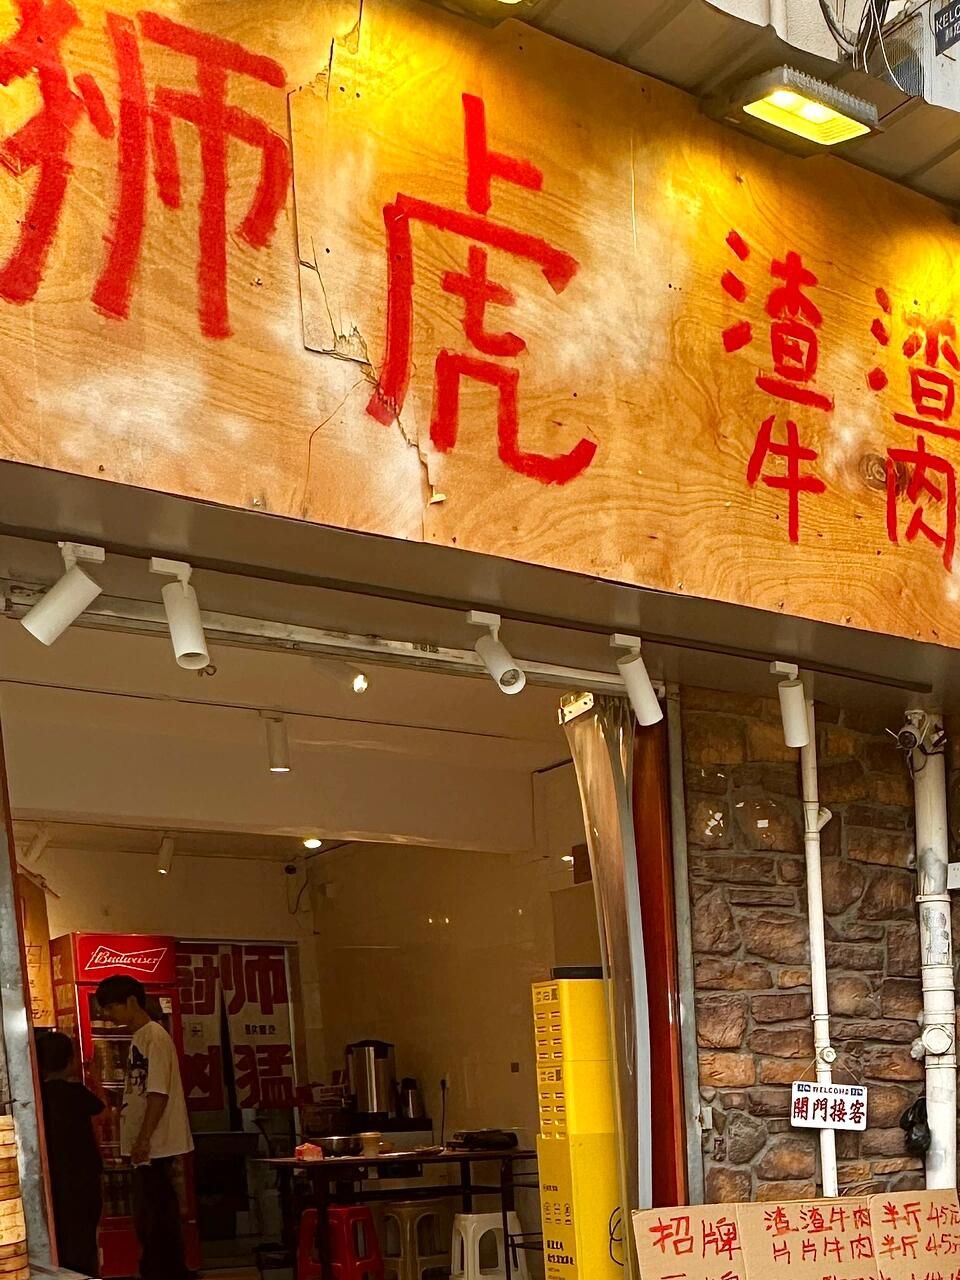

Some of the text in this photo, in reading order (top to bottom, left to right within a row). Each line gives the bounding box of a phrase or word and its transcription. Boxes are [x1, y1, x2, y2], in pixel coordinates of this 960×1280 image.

[94, 950, 160, 966] Budweiser
[812, 1086, 849, 1095] WELCOME
[793, 1096, 865, 1124] 開門接客
[764, 1206, 872, 1237] 渣渣牛肉
[650, 1215, 742, 1261] 招牌
[772, 1236, 875, 1264] 片片牛肉
